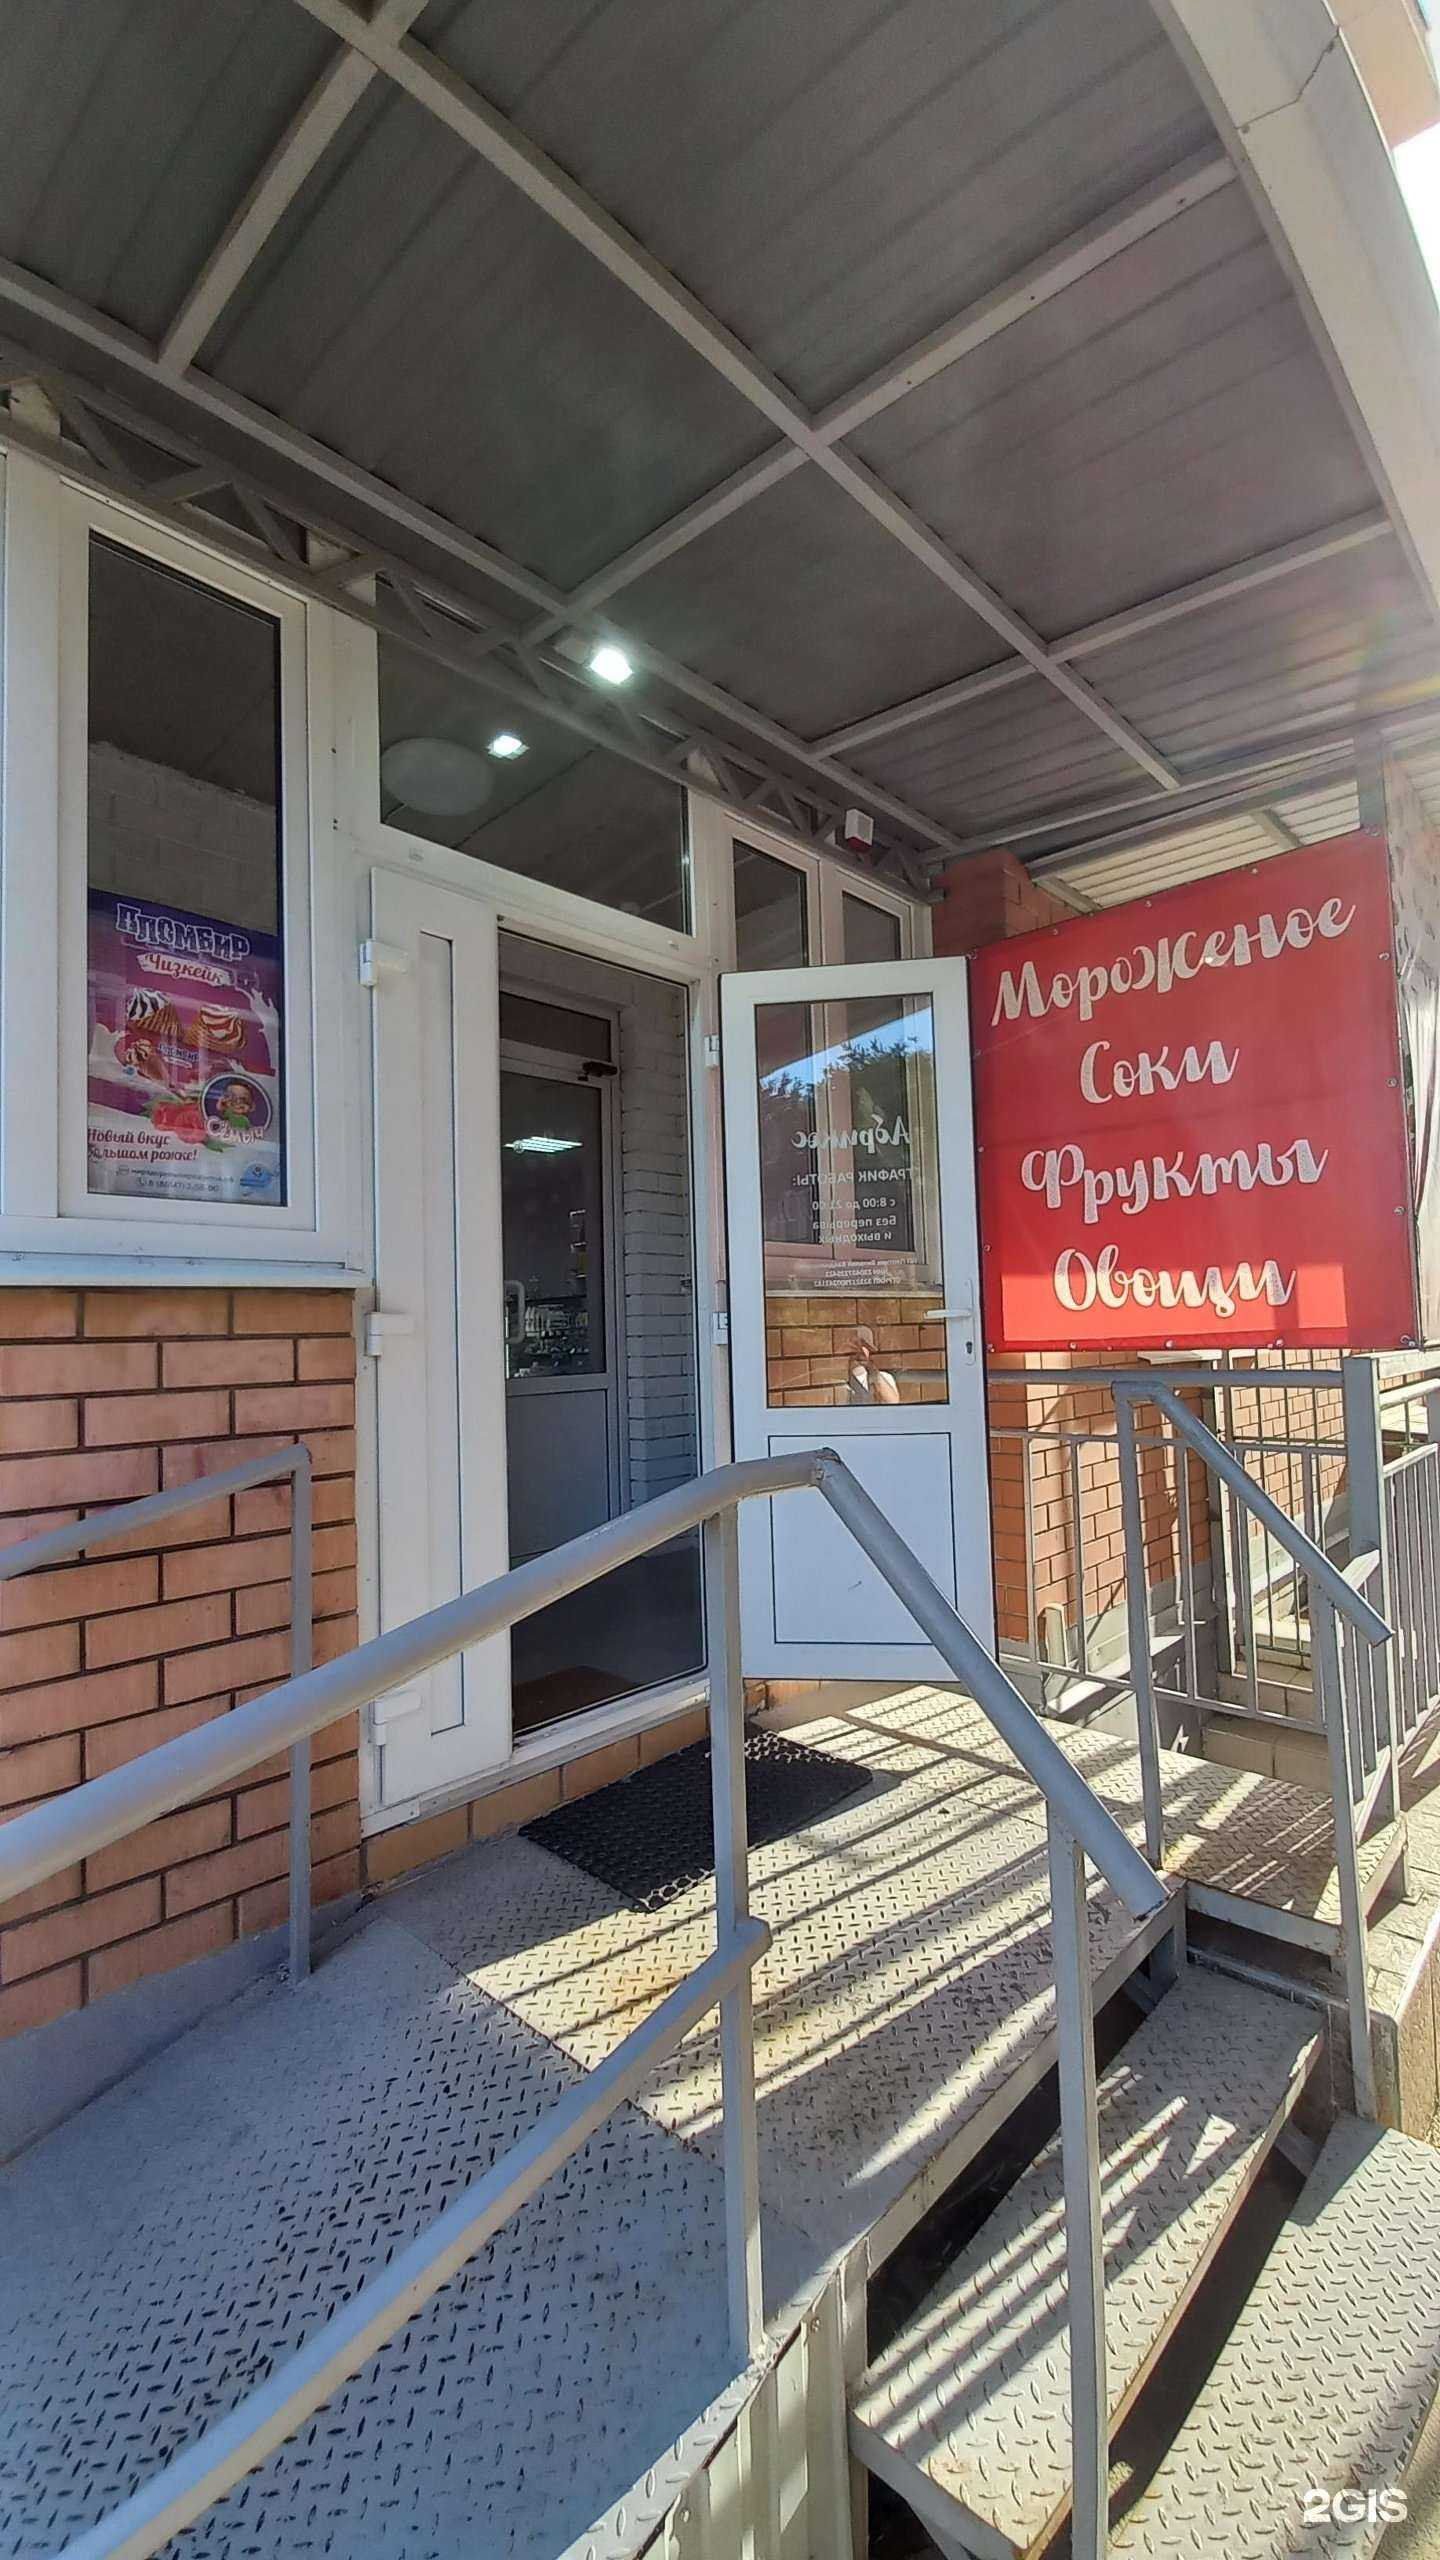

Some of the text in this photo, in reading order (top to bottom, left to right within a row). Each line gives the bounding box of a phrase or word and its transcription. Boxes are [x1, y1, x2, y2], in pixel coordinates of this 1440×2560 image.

[116, 903, 250, 963] ПЛОМБИР
[991, 898, 1356, 1026] Мороженое
[145, 953, 224, 984] Чизкейк
[1080, 1040, 1239, 1103] Соки
[1021, 1139, 1328, 1224] Фрукты
[1054, 1244, 1296, 1318] Овощи
